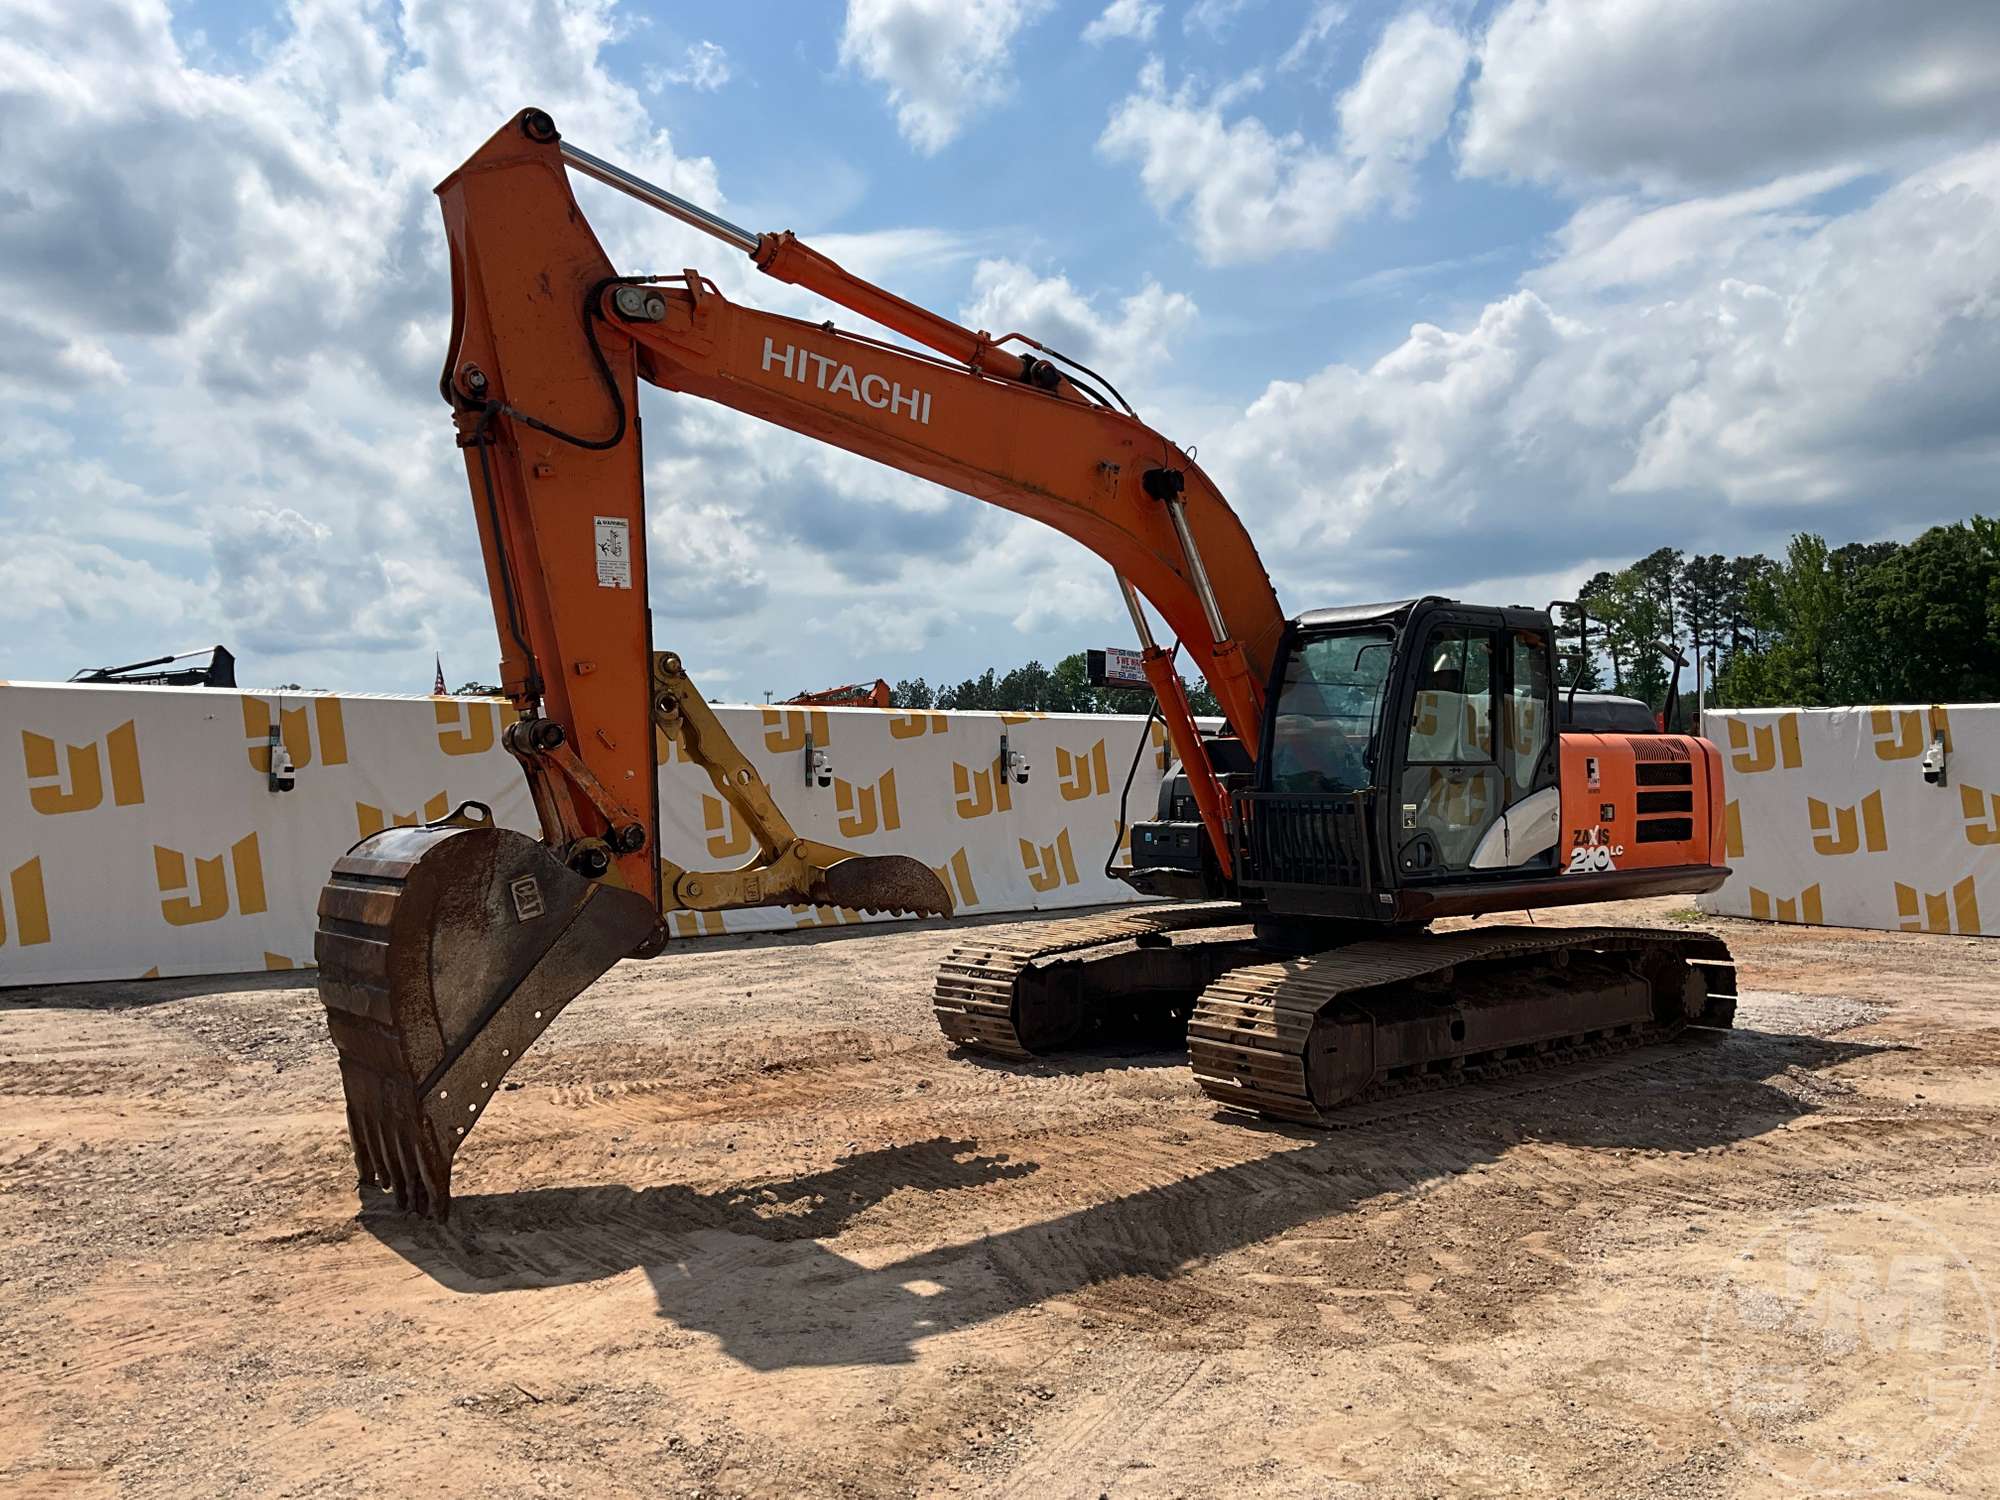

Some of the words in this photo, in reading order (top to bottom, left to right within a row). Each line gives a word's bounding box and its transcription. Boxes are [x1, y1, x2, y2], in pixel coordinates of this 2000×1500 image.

[761, 336, 931, 424] HITACHI
[1573, 825, 1610, 846] ZAXIS
[513, 879, 543, 917] CAT
